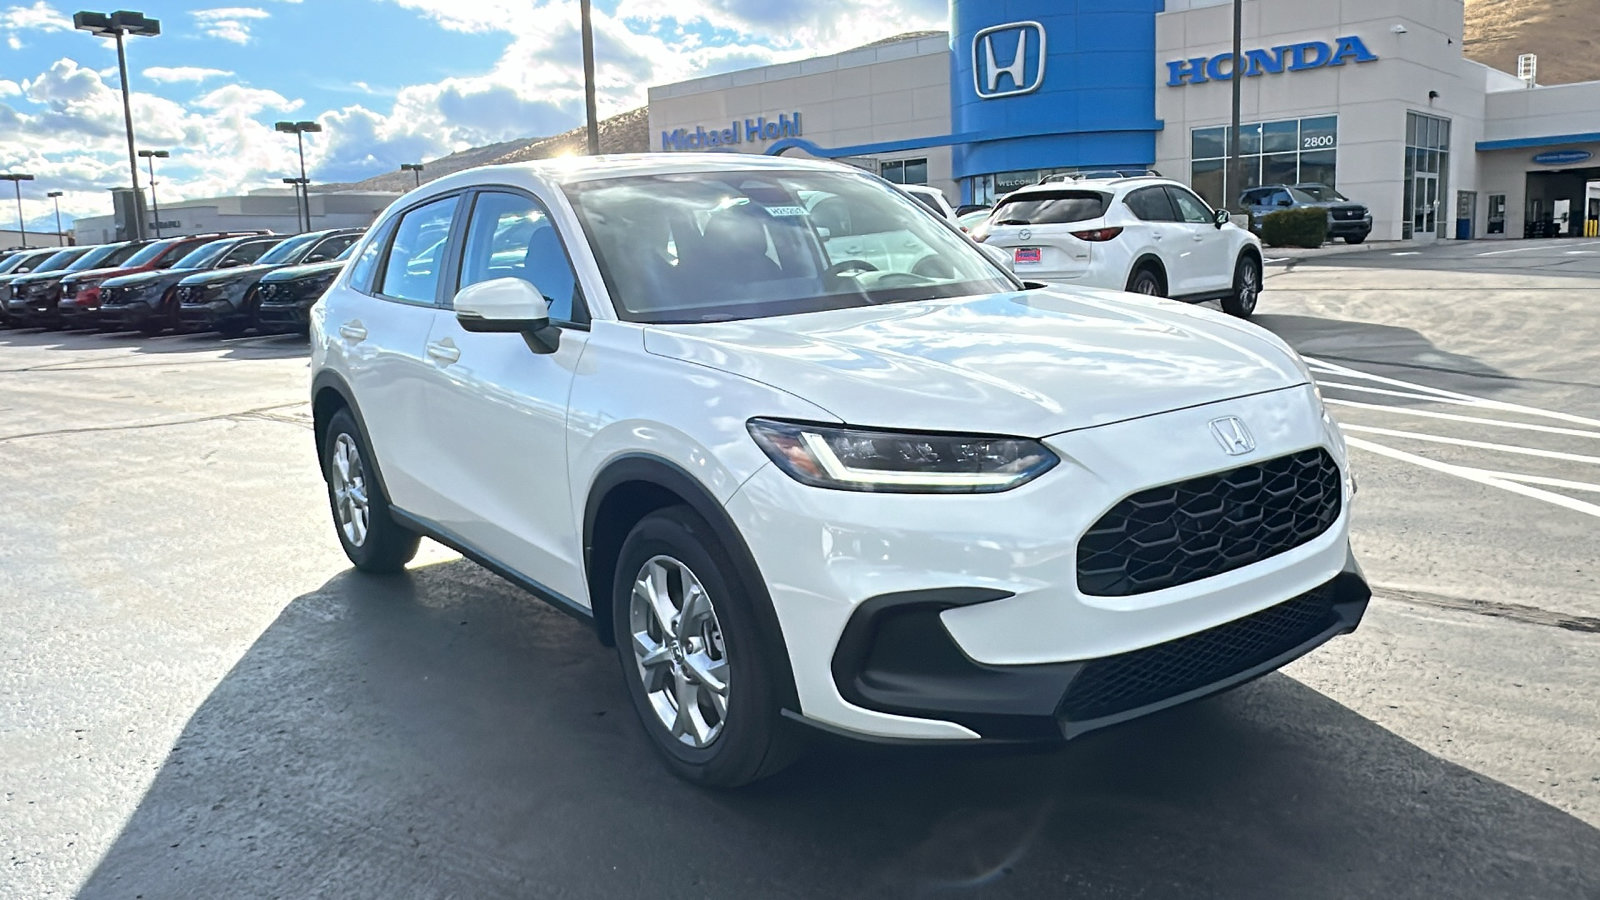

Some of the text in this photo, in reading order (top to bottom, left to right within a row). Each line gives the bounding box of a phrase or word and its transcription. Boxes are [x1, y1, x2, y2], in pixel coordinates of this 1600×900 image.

[1166, 35, 1379, 87] HONDA
[662, 112, 802, 150] Michael Hohl
[1304, 135, 1334, 148] 2800
